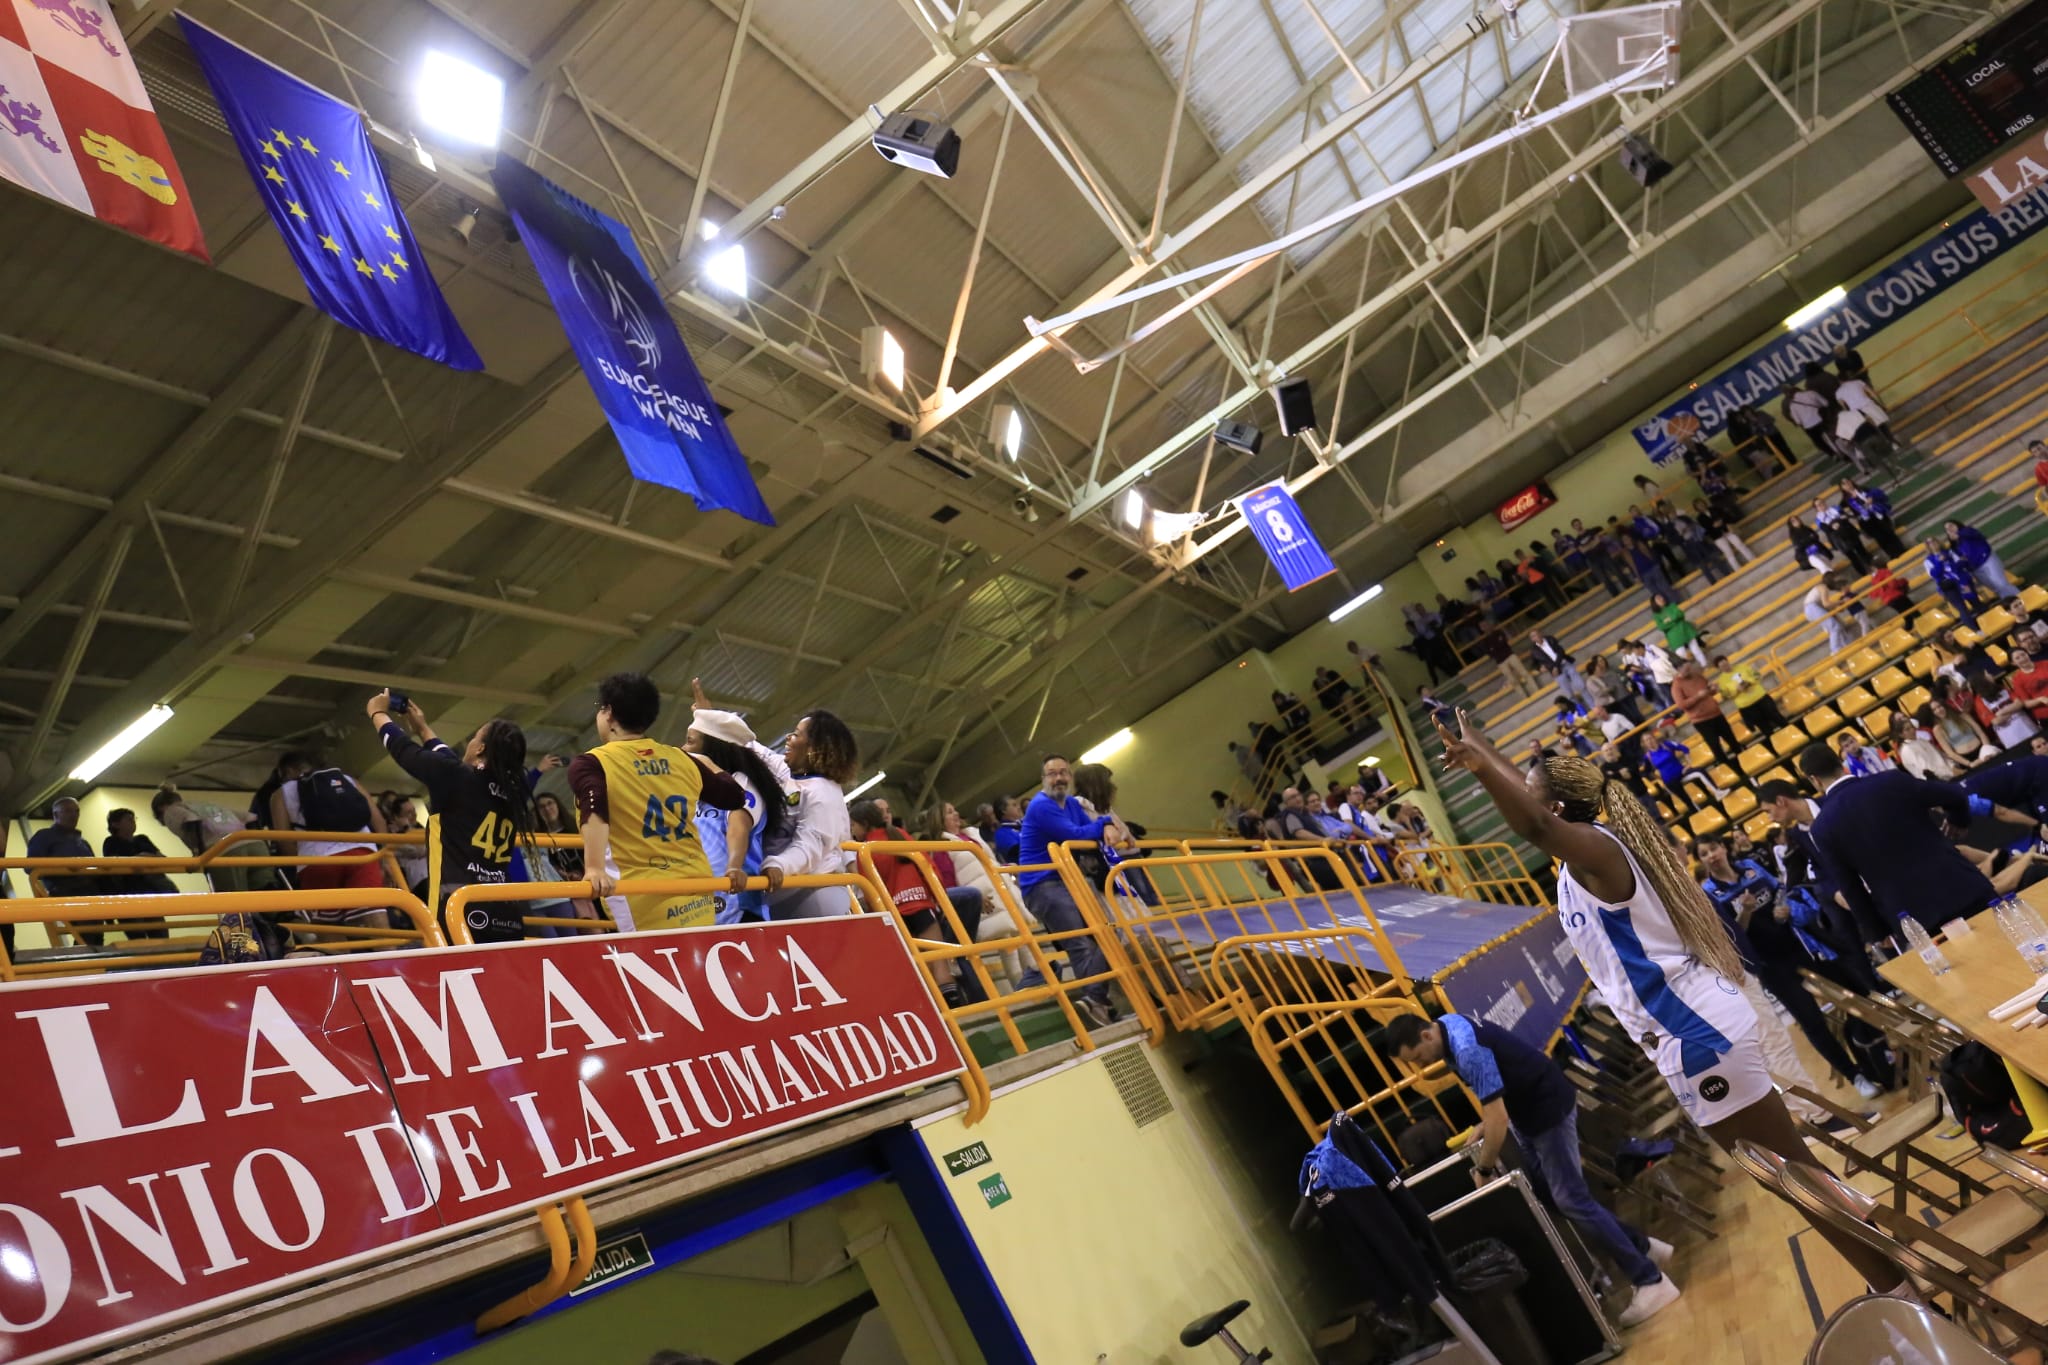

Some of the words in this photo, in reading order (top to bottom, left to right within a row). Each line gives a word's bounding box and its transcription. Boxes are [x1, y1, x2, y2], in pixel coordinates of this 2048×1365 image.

[1965, 60, 2006, 87] LOCAL
[2005, 114, 2035, 136] FALTAS
[1693, 307, 1871, 430] SALAMANCA
[1865, 259, 1938, 319] CON
[1931, 220, 1999, 277] SUS
[1999, 182, 2048, 238] REI
[1266, 509, 1293, 542] 8
[471, 811, 514, 863] 42
[642, 793, 693, 842] 42
[0, 934, 848, 1158] LAMANCA
[1704, 1082, 1725, 1096] 1954
[344, 1105, 512, 1224] DE
[509, 1079, 636, 1178] LA
[626, 1011, 937, 1144] HUMANIDAD
[959, 1145, 989, 1168] SALIDA
